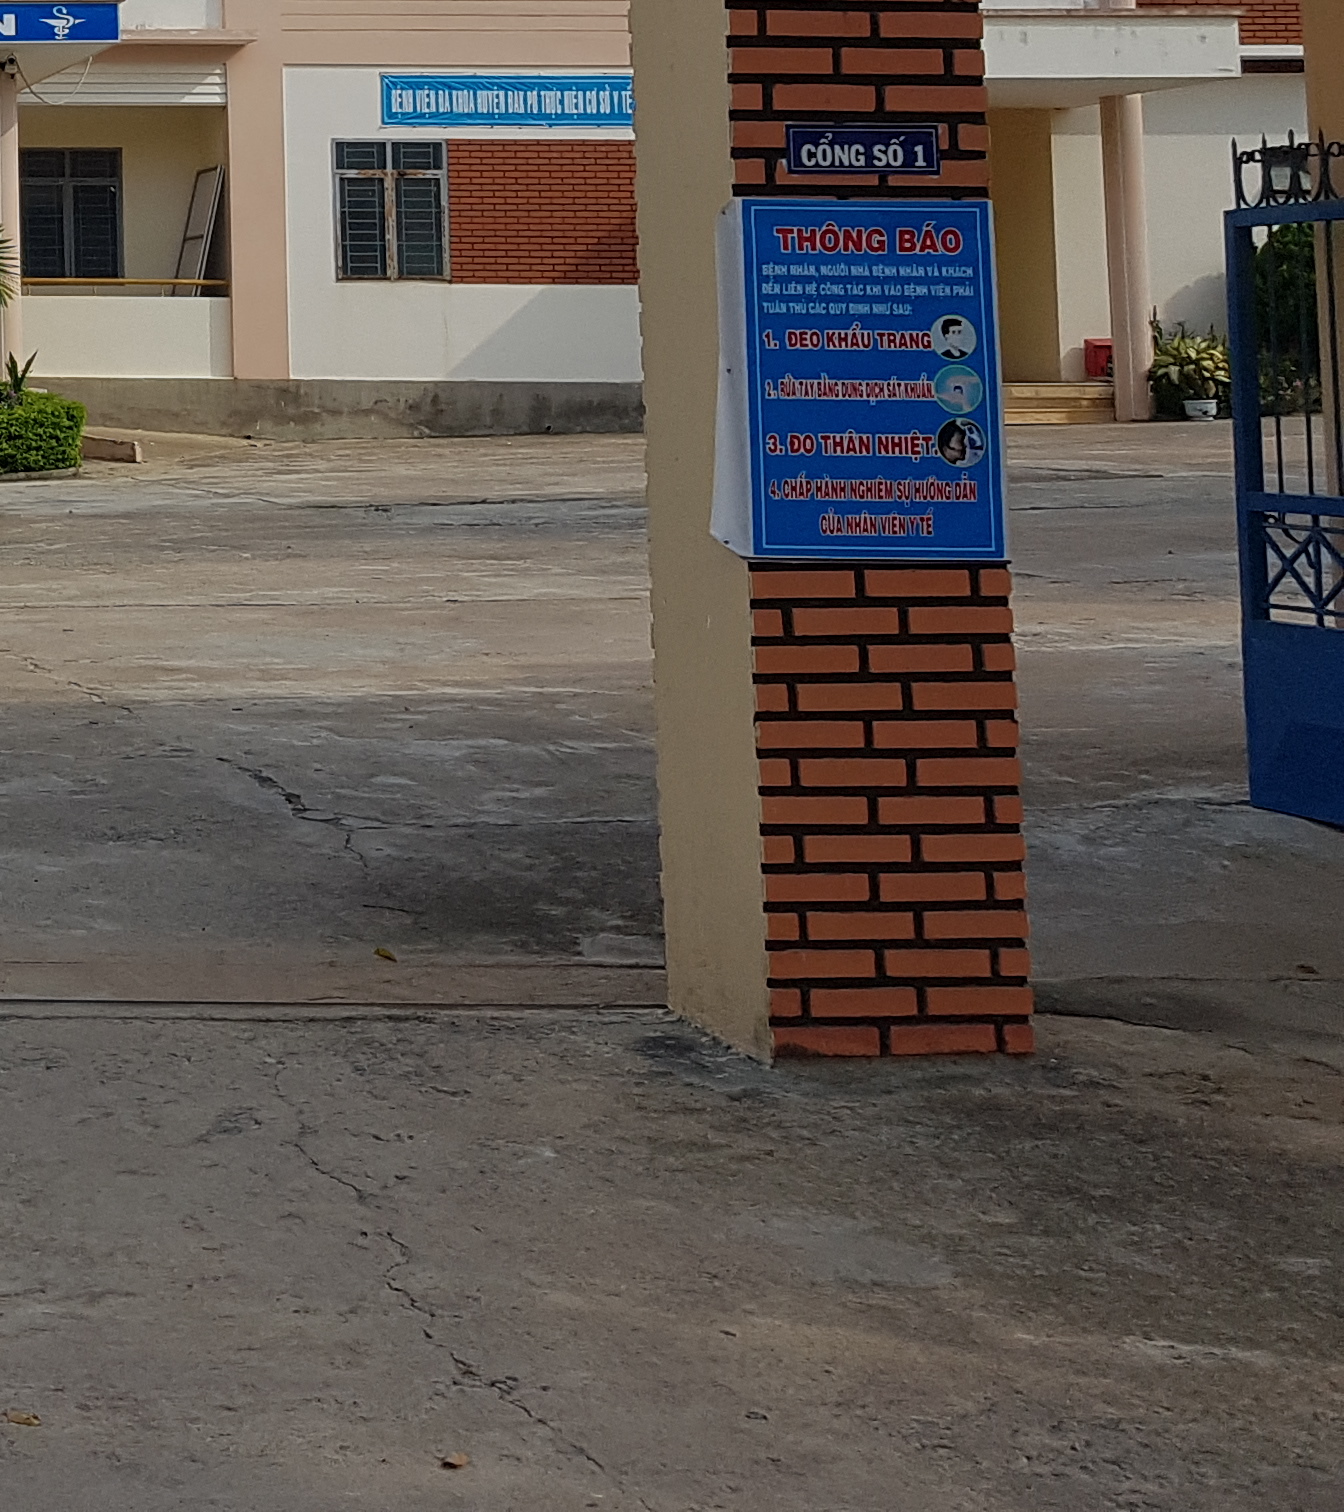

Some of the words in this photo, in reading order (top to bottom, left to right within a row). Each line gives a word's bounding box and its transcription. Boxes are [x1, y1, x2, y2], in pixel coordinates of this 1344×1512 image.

[800, 133, 866, 167] CỔNG
[872, 135, 905, 167] SỐ
[914, 144, 927, 167] 1
[773, 221, 888, 254] THÔNG
[896, 220, 963, 255] BÁO
[763, 330, 779, 349] 1.
[786, 330, 821, 349] ĐEO
[824, 322, 872, 350] KHẨU
[877, 330, 934, 351] TRANG
[766, 379, 778, 399] 2.
[766, 434, 784, 455] 3.
[787, 434, 816, 455] ĐO
[819, 428, 872, 456] THÂN
[769, 479, 781, 500] 4.
[781, 471, 813, 500] CHẤP
[814, 472, 848, 501] HÀNH
[849, 474, 894, 502] NGHIÊM
[896, 477, 913, 507] SỰ
[819, 507, 844, 536] CỦA
[845, 510, 879, 536] NHÂN
[880, 511, 908, 536] VIÊN
[908, 515, 919, 536] Y
[919, 507, 934, 536] TẾ
